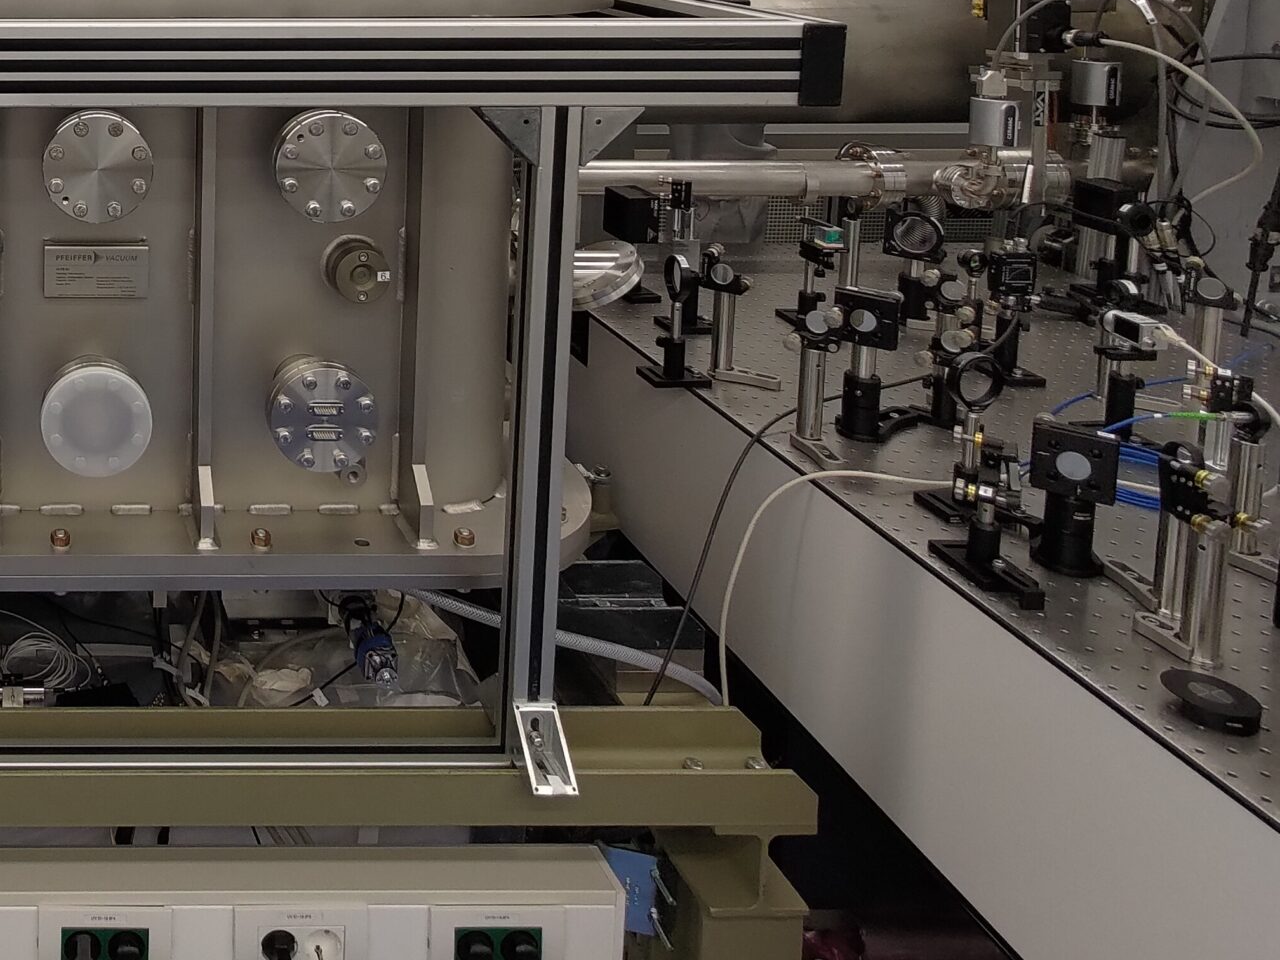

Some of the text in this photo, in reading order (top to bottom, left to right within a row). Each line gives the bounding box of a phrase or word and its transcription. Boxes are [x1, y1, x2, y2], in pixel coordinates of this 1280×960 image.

[1035, 93, 1045, 125] VAT
[56, 254, 138, 262] PFEIFFER VACUUM
